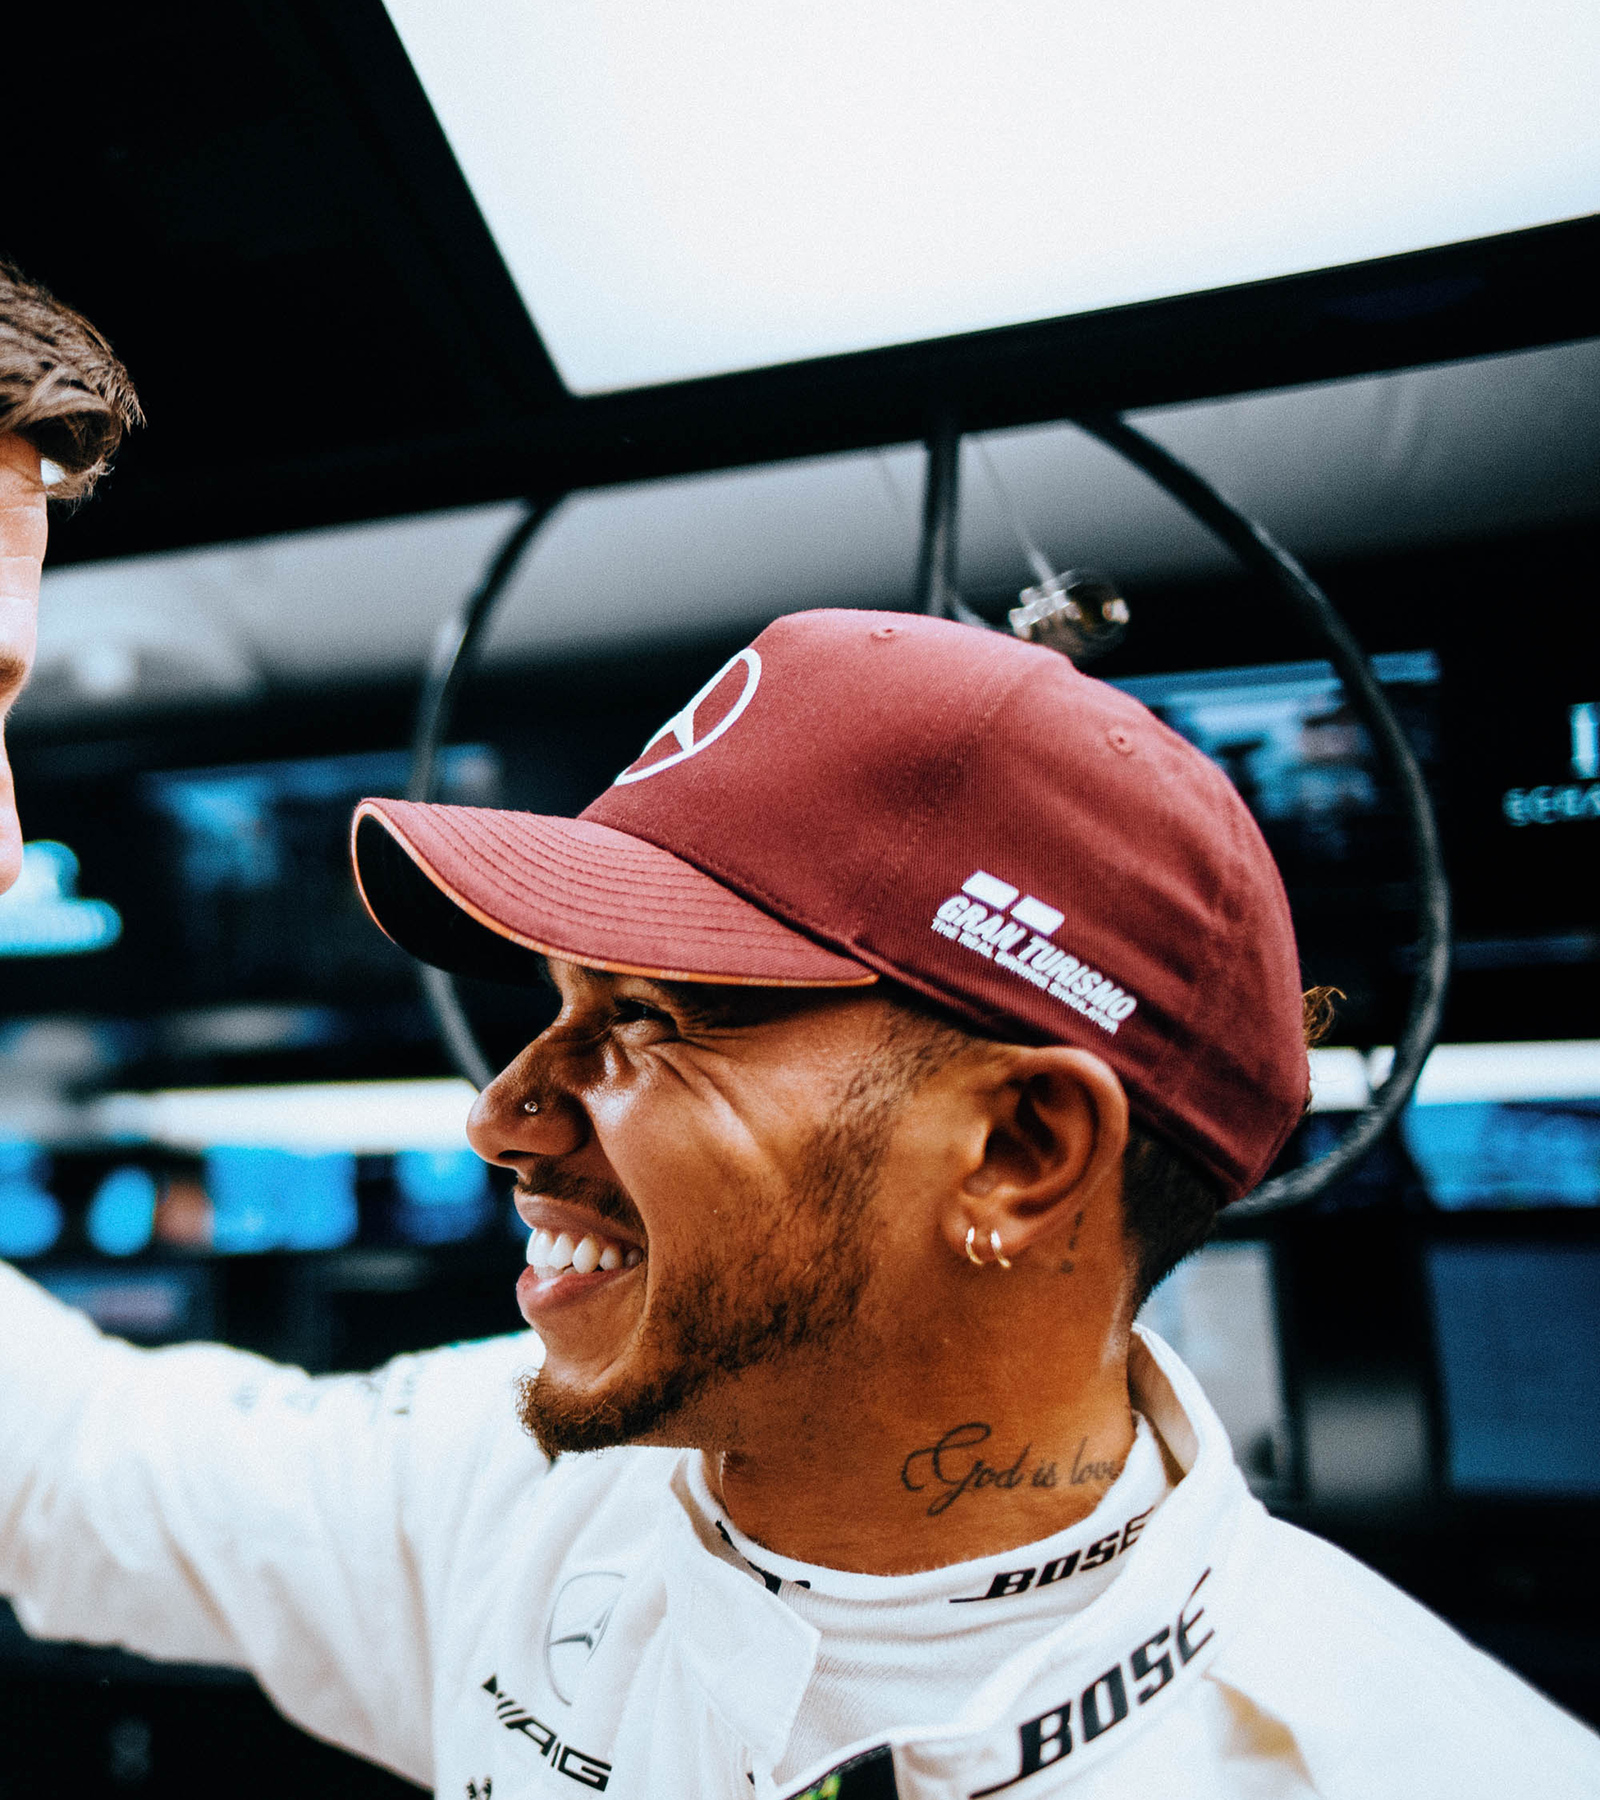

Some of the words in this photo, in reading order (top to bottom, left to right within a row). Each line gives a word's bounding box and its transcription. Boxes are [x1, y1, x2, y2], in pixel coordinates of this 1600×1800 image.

[936, 895, 1027, 952] GRAN
[1018, 934, 1138, 1022] TURISMO
[901, 1420, 1032, 1517] God
[1032, 1463, 1057, 1489] is
[949, 1505, 1155, 1604] BOSE
[969, 1566, 1215, 1800] BOSE
[505, 1715, 613, 1792] AG
